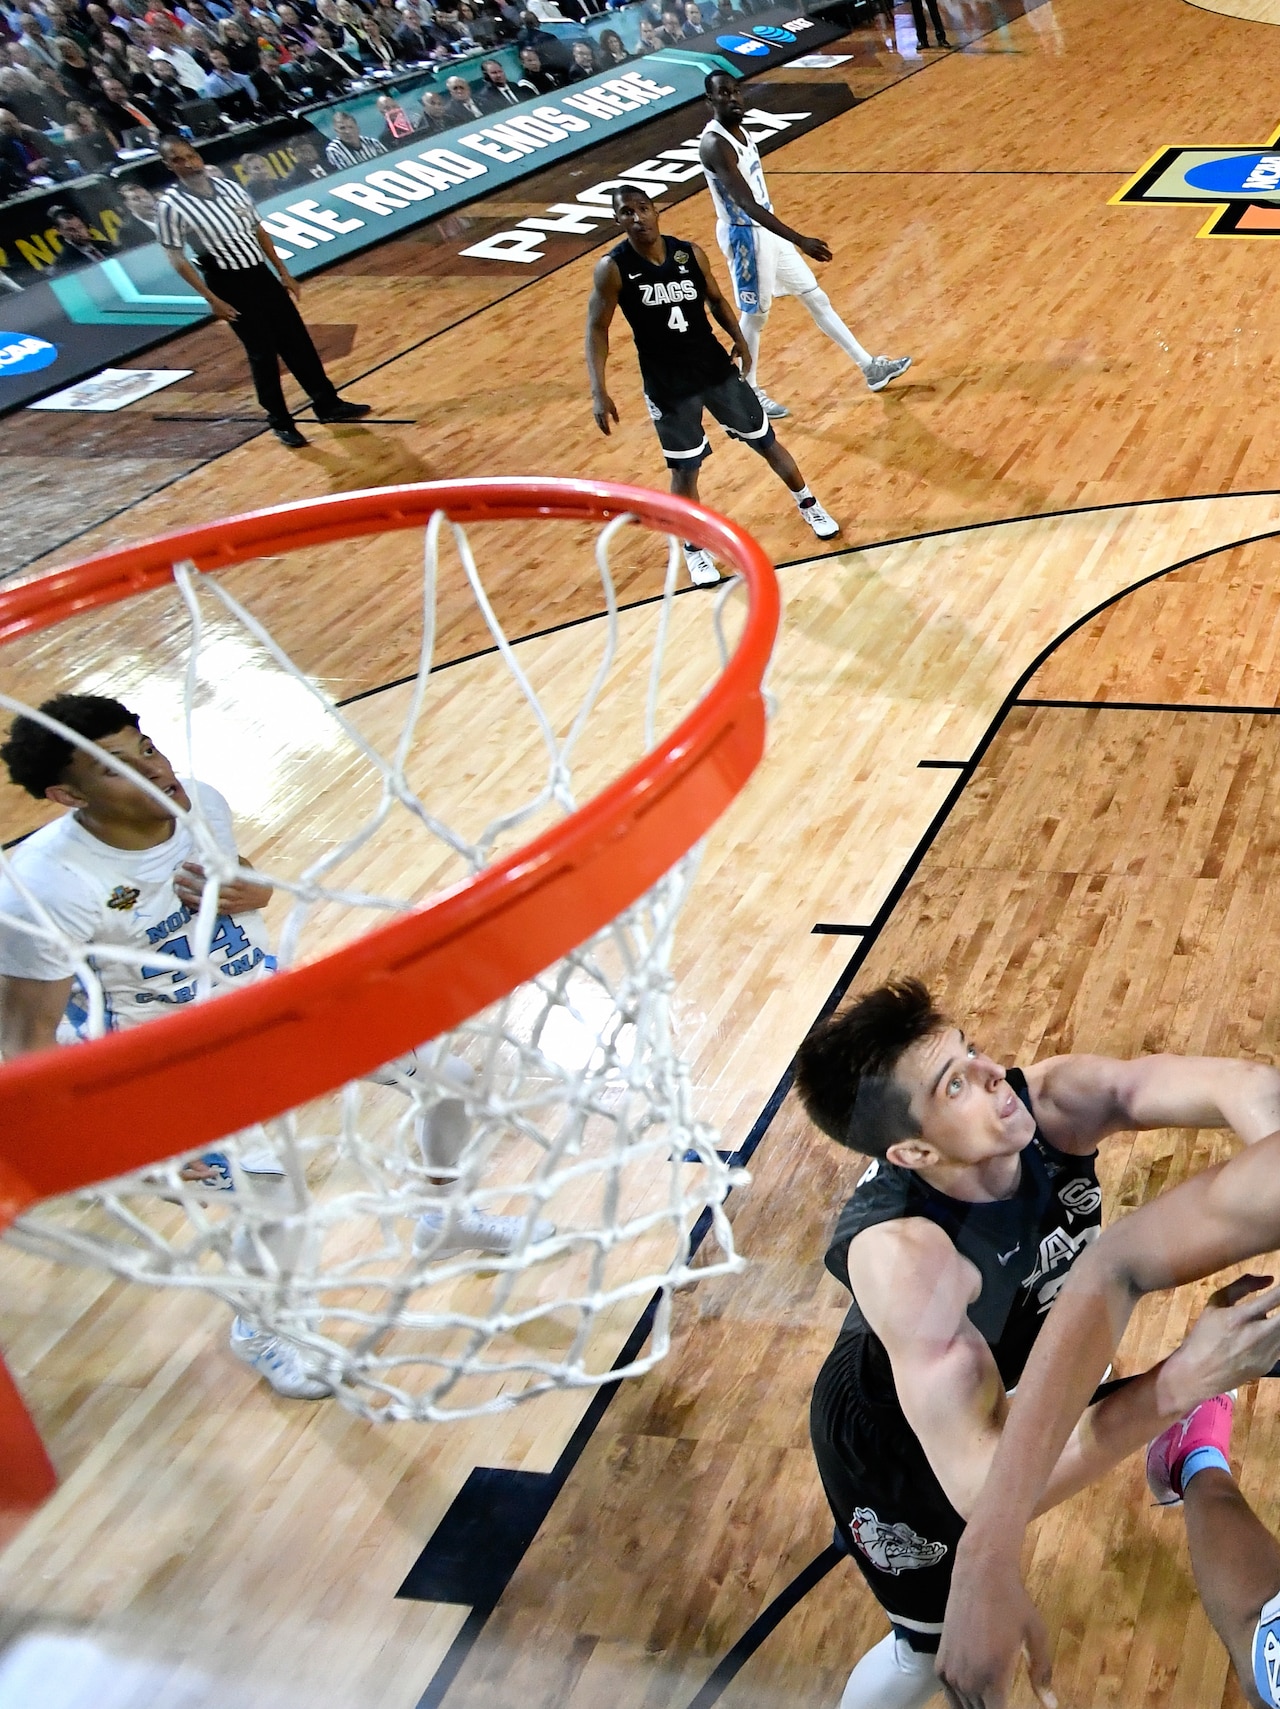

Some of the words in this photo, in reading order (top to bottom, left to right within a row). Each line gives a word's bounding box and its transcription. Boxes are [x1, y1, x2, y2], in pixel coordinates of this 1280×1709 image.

[329, 148, 489, 217] ROAD
[457, 106, 591, 163] ENDS
[562, 71, 676, 121] HERE
[638, 279, 698, 307] ZAGS
[667, 306, 689, 333] 4
[0, 338, 53, 369] CAA
